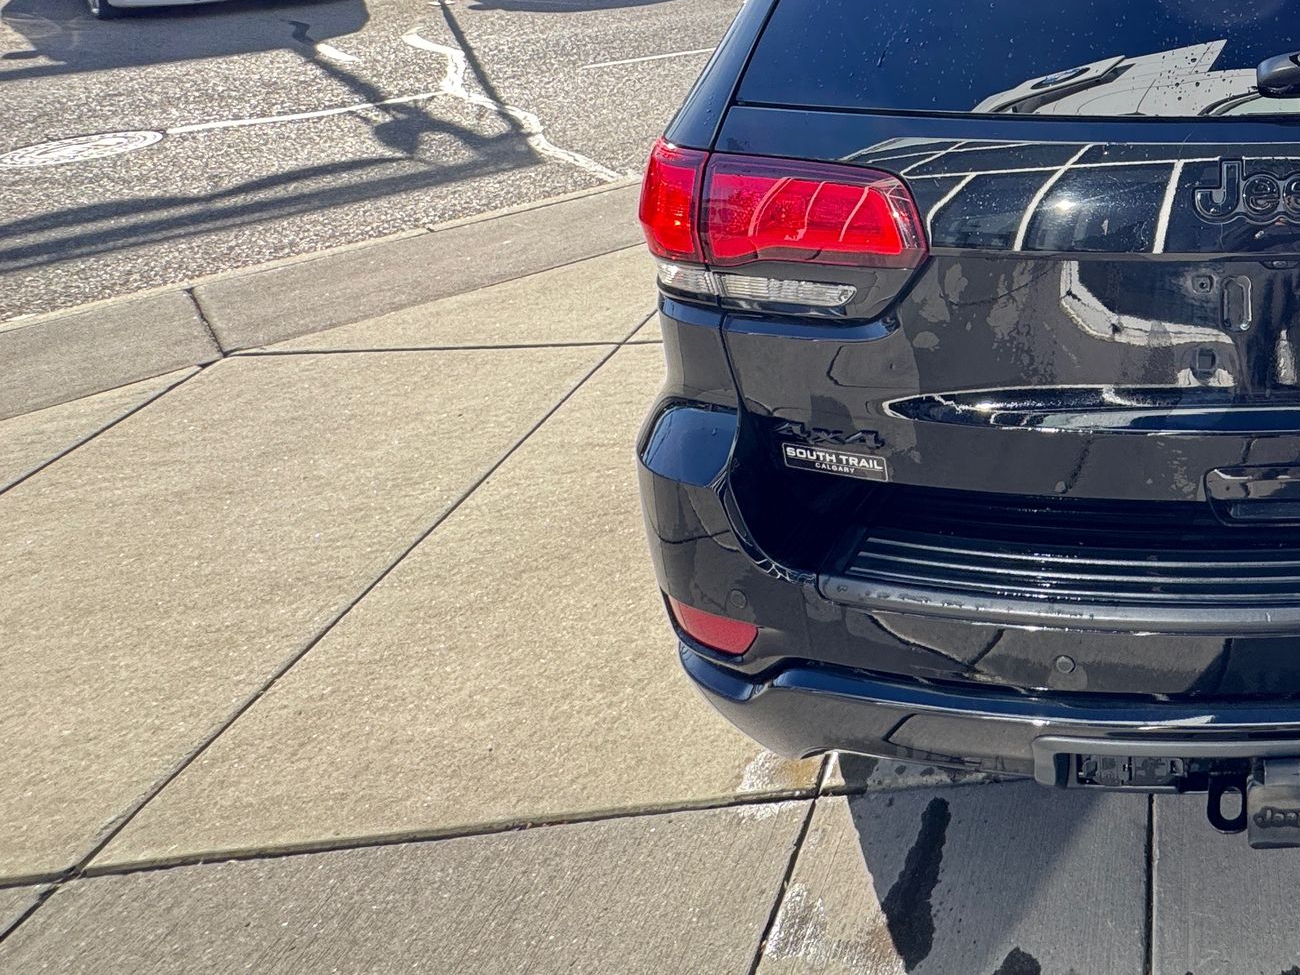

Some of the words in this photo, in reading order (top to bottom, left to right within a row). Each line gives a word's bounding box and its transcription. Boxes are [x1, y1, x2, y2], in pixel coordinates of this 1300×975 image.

[786, 446, 837, 464] SOUTH
[838, 455, 884, 471] TRAIL
[815, 462, 855, 475] CALGARY
